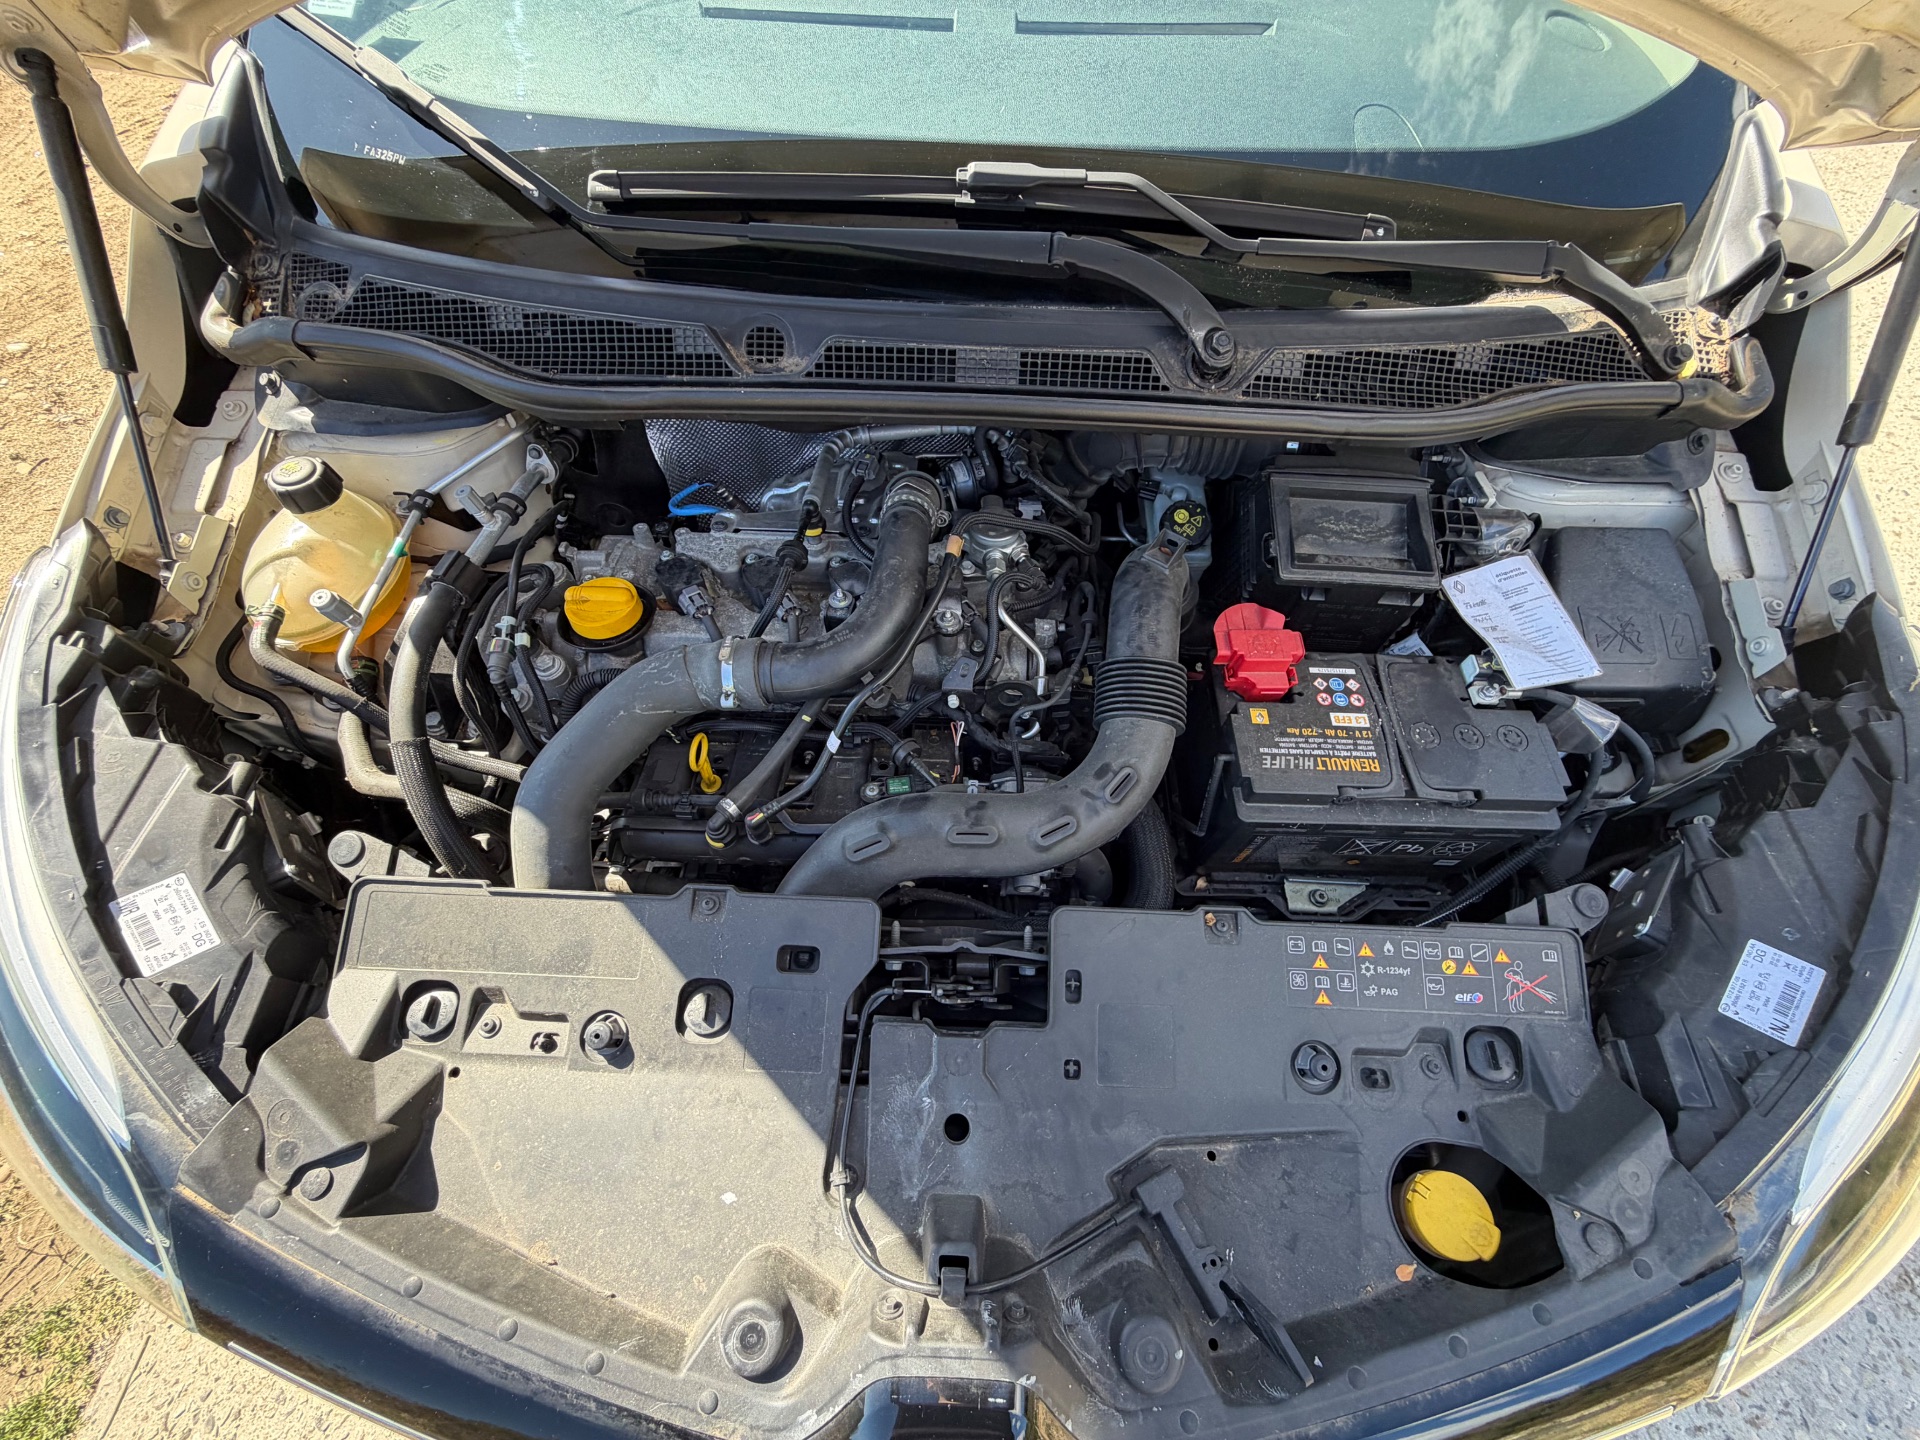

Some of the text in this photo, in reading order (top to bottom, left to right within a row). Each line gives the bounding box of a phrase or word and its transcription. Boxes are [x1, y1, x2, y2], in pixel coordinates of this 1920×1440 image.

[364, 145, 406, 165] FA325PW
[1334, 716, 1352, 724] EFB
[1317, 757, 1380, 772] RENAULT
[1393, 843, 1424, 853] Pb
[192, 932, 206, 947] DG
[1753, 949, 1767, 964] DG
[1377, 967, 1411, 976] R-1234yf
[1455, 993, 1472, 1001] elf
[1768, 1017, 1790, 1036] NJ
